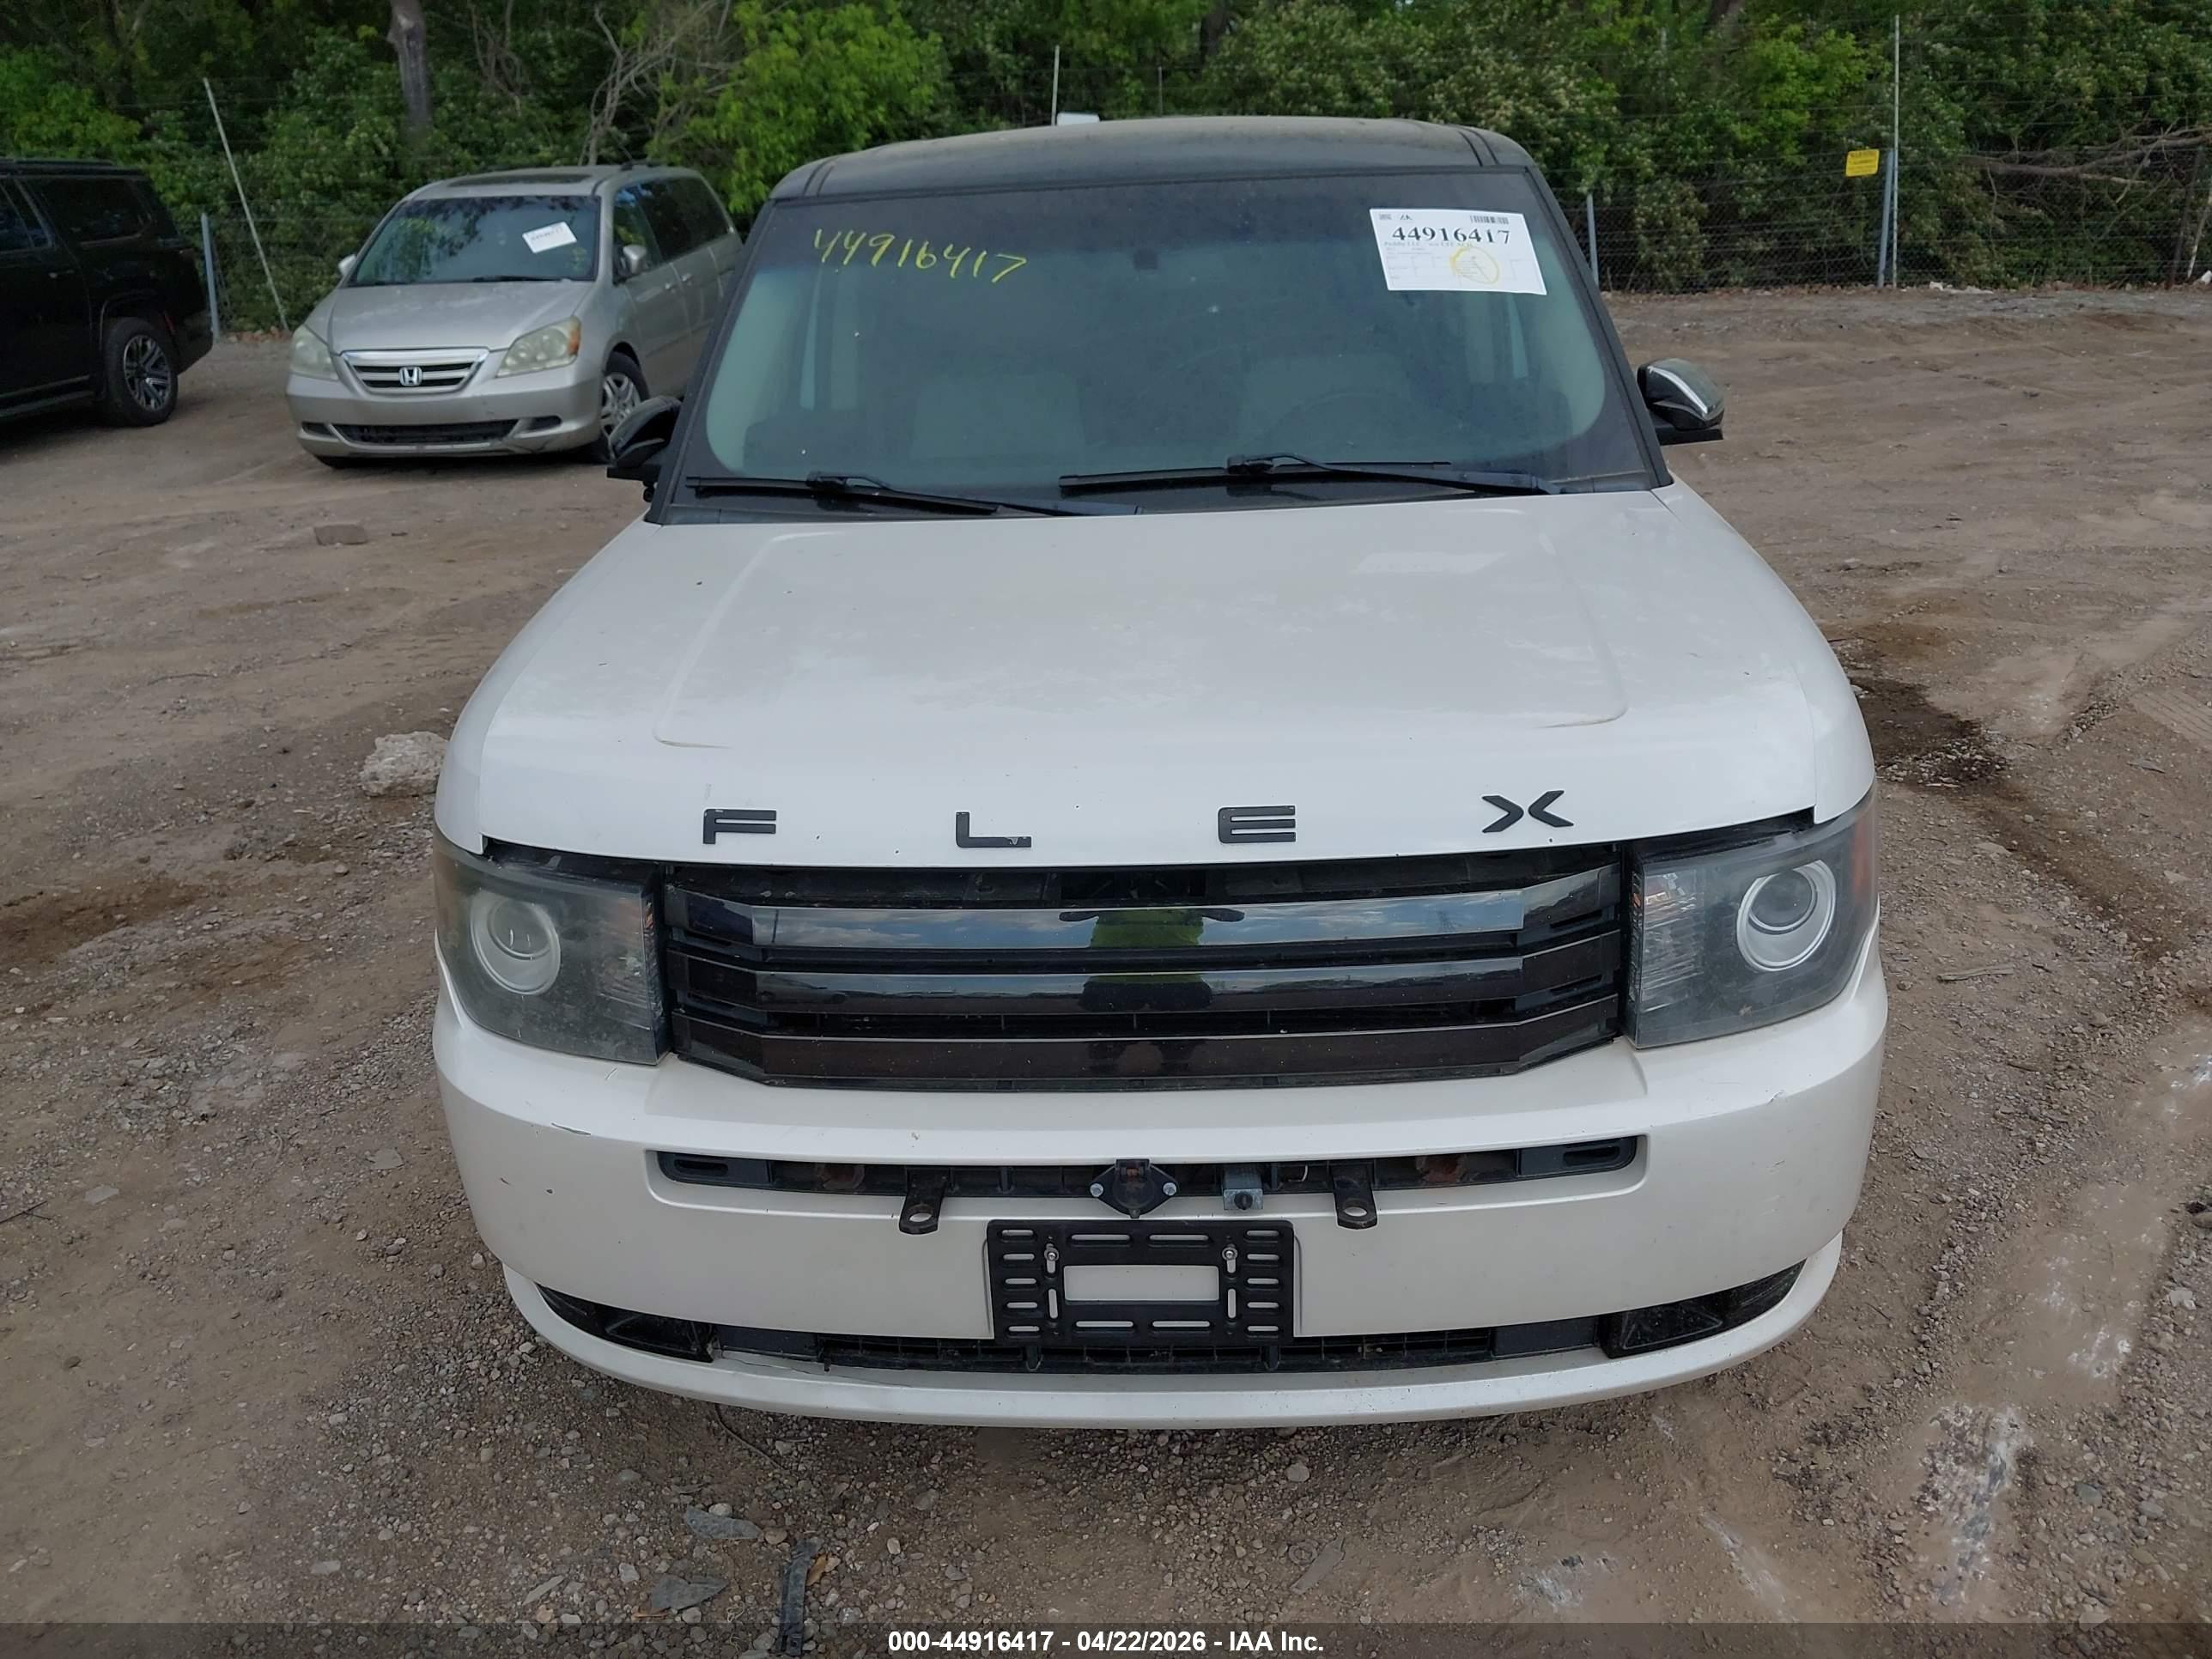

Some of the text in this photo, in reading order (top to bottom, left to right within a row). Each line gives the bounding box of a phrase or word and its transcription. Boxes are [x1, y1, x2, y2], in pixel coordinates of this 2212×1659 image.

[813, 228, 1028, 283] 44916417
[1392, 226, 1510, 245] 44916417
[702, 788, 1573, 848] FLEX
